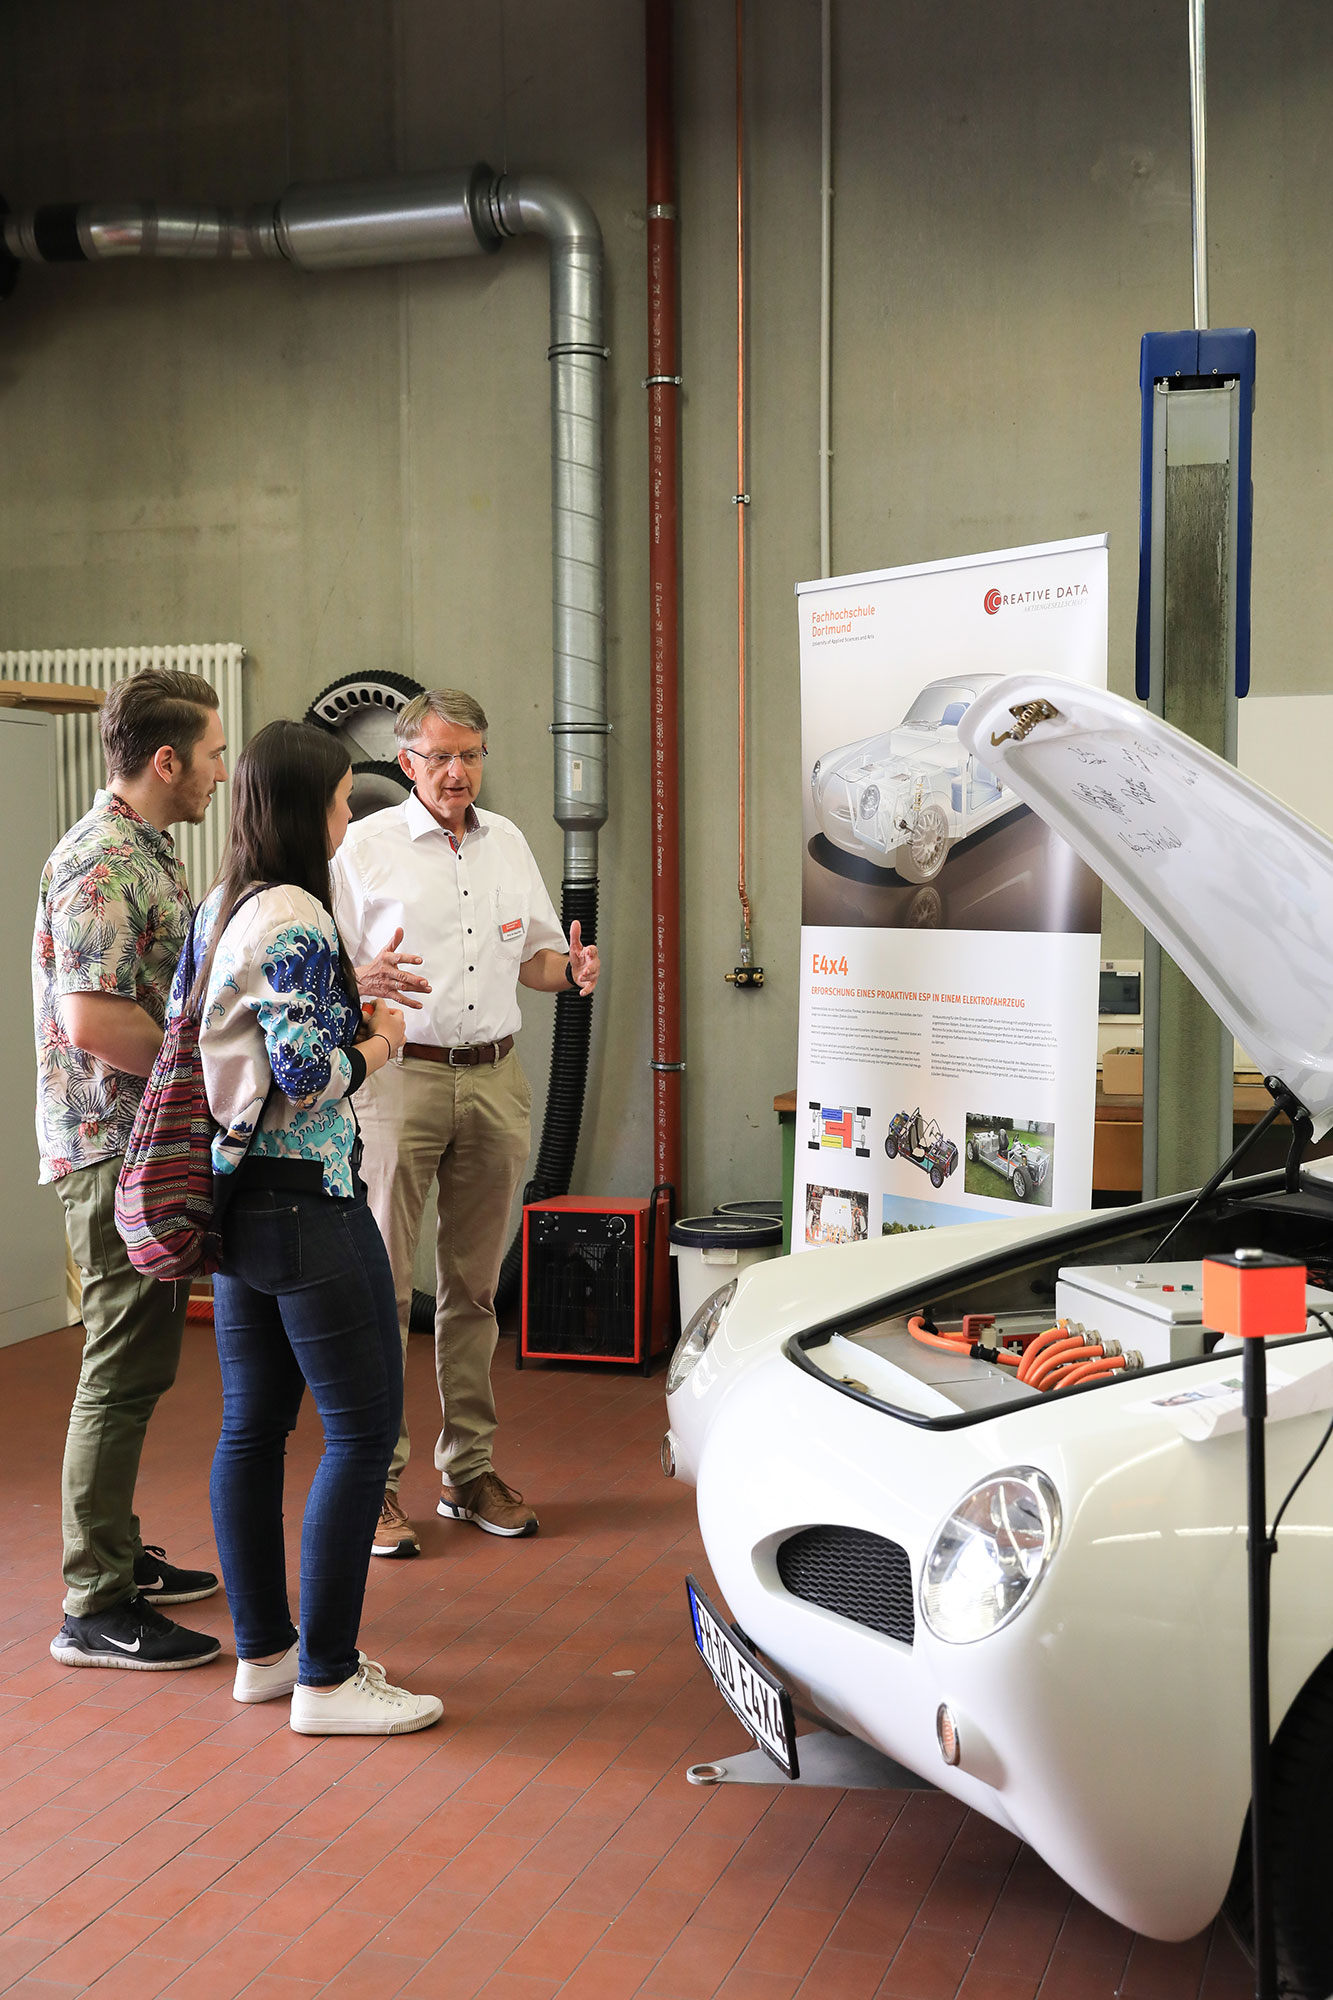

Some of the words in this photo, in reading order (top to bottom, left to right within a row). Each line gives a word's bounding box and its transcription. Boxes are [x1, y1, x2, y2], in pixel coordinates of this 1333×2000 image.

[1057, 584, 1088, 598] DATA
[812, 604, 875, 623] Fachhochschule
[812, 621, 852, 637] Dortmund
[812, 953, 849, 976] E4x4
[811, 986, 856, 997] ERFORSCHUNG
[856, 989, 876, 998] EINES
[876, 990, 918, 1001] PROAKTIVEN
[918, 992, 931, 1002] ESP
[932, 993, 940, 1002] IN
[940, 993, 962, 1003] EINEM
[962, 995, 1026, 1008] ELEKTROFAHRZEUG
[696, 1600, 735, 1692] FH-DO
[738, 1659, 787, 1754] E4X4
